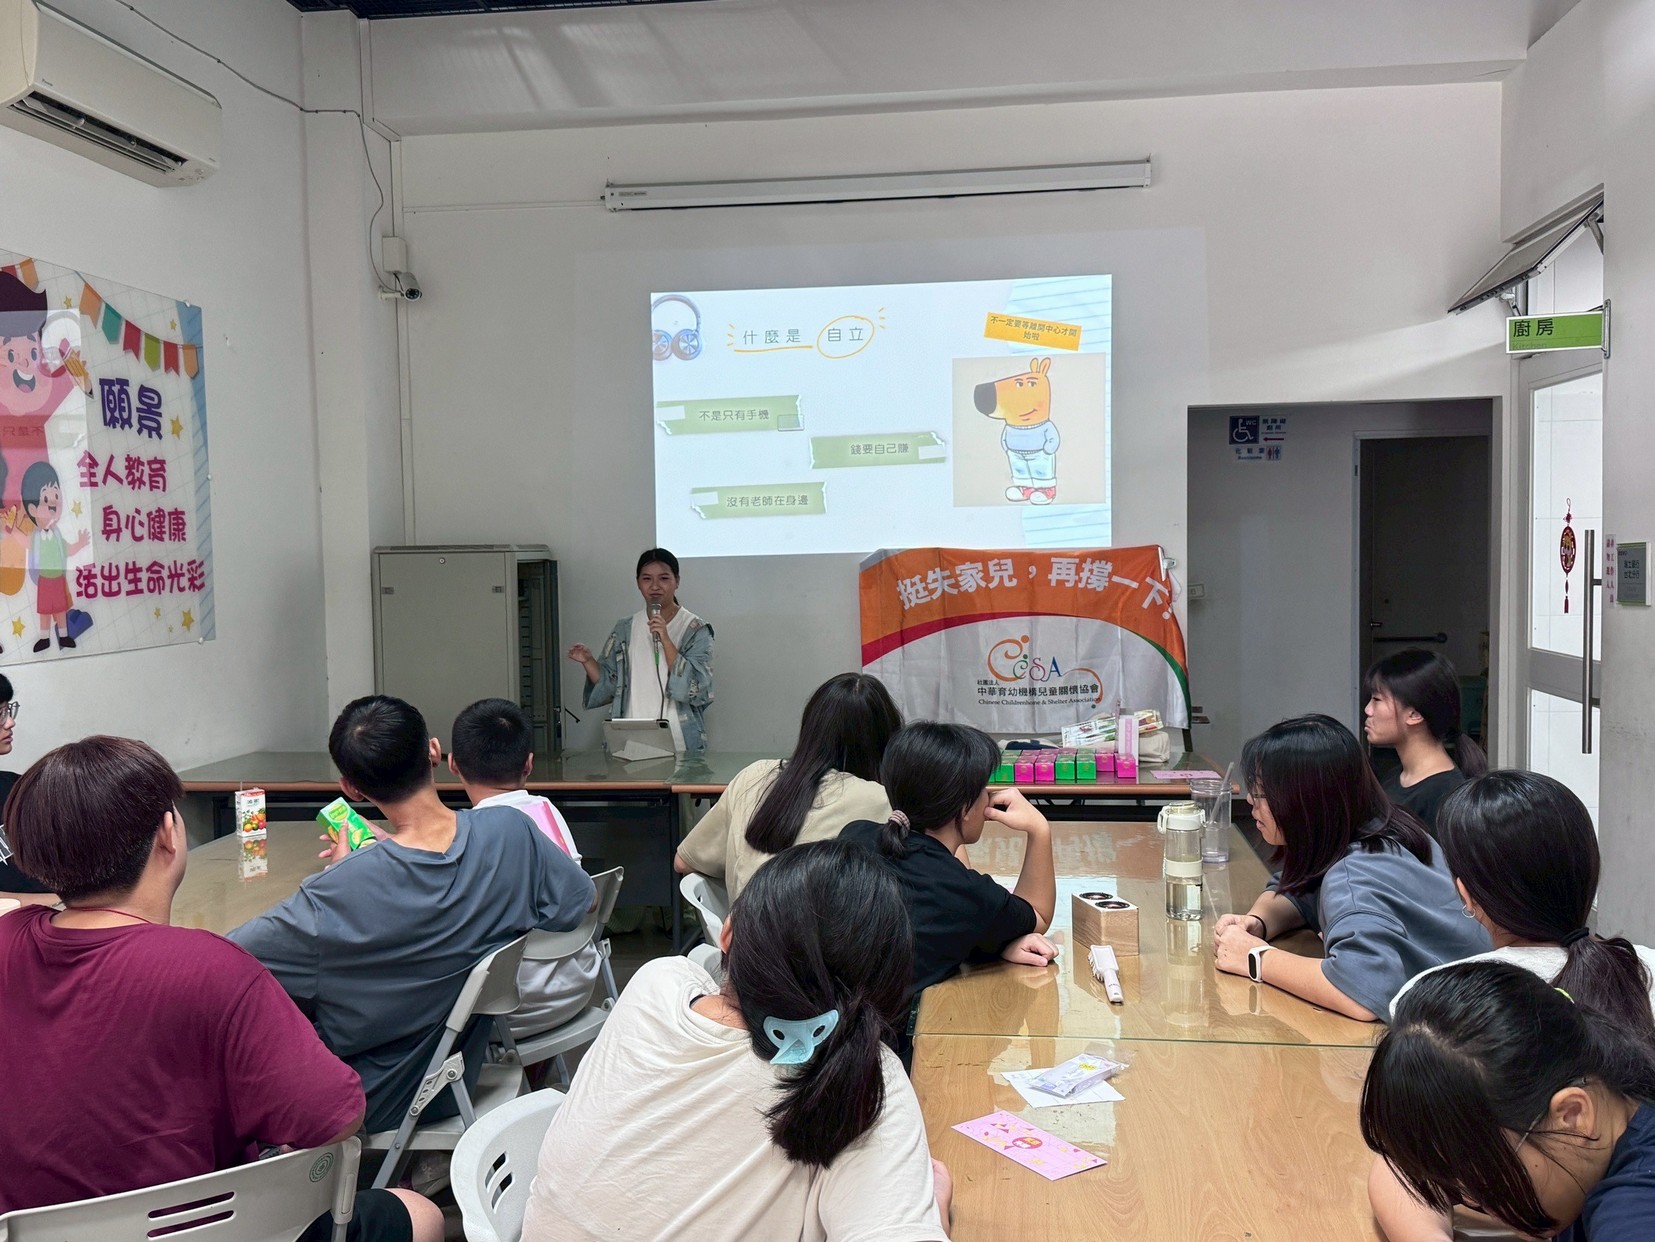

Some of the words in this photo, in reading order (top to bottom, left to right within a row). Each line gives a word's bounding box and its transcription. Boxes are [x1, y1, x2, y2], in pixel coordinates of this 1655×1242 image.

[990, 316, 1077, 337] 不一定要等離開中心才開
[1513, 318, 1554, 337] 廚房
[743, 328, 801, 345] 什麼是
[828, 327, 864, 342] 自立
[1023, 331, 1040, 341] 始啦
[99, 378, 163, 440] 願景
[699, 408, 769, 421] 不是只有手機
[850, 443, 909, 455] 錢要自己賺
[77, 450, 167, 492] 全人教育
[726, 494, 809, 508] 沒有老師在身邊
[101, 504, 186, 542] 身心健康
[75, 558, 206, 599] 活出生命光彩
[977, 683, 1099, 697] 中華育幼機構兒童關懷協會
